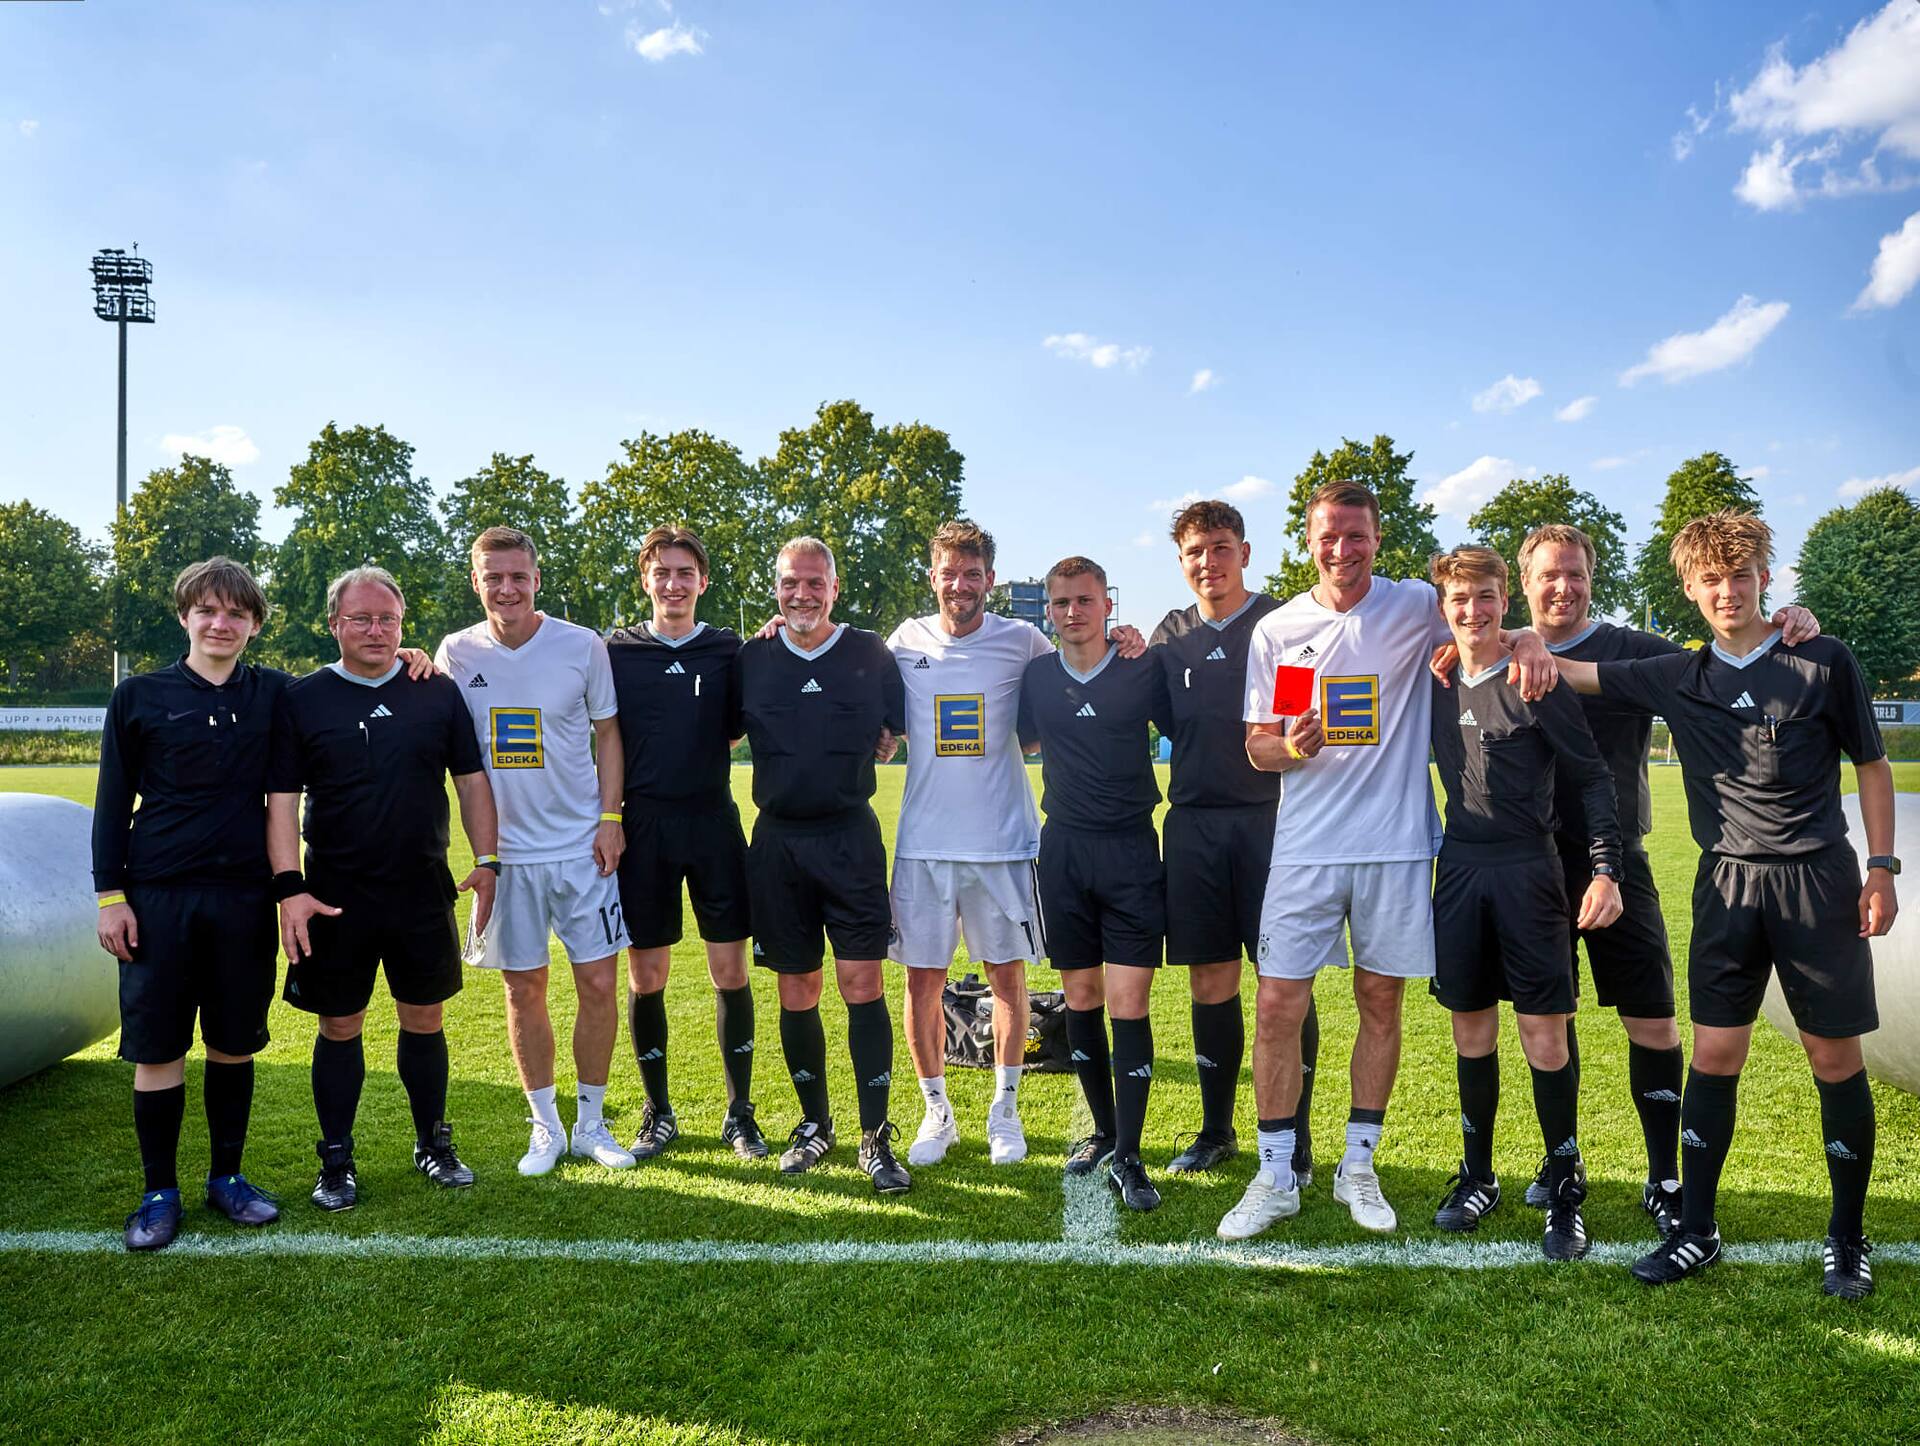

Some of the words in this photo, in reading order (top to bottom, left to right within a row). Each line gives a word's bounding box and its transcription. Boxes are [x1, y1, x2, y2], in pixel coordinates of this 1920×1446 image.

[46, 715, 103, 724] PARTNER
[1327, 730, 1374, 740] EDEKA
[940, 743, 980, 752] EDEKA
[497, 755, 539, 764] EDEKA
